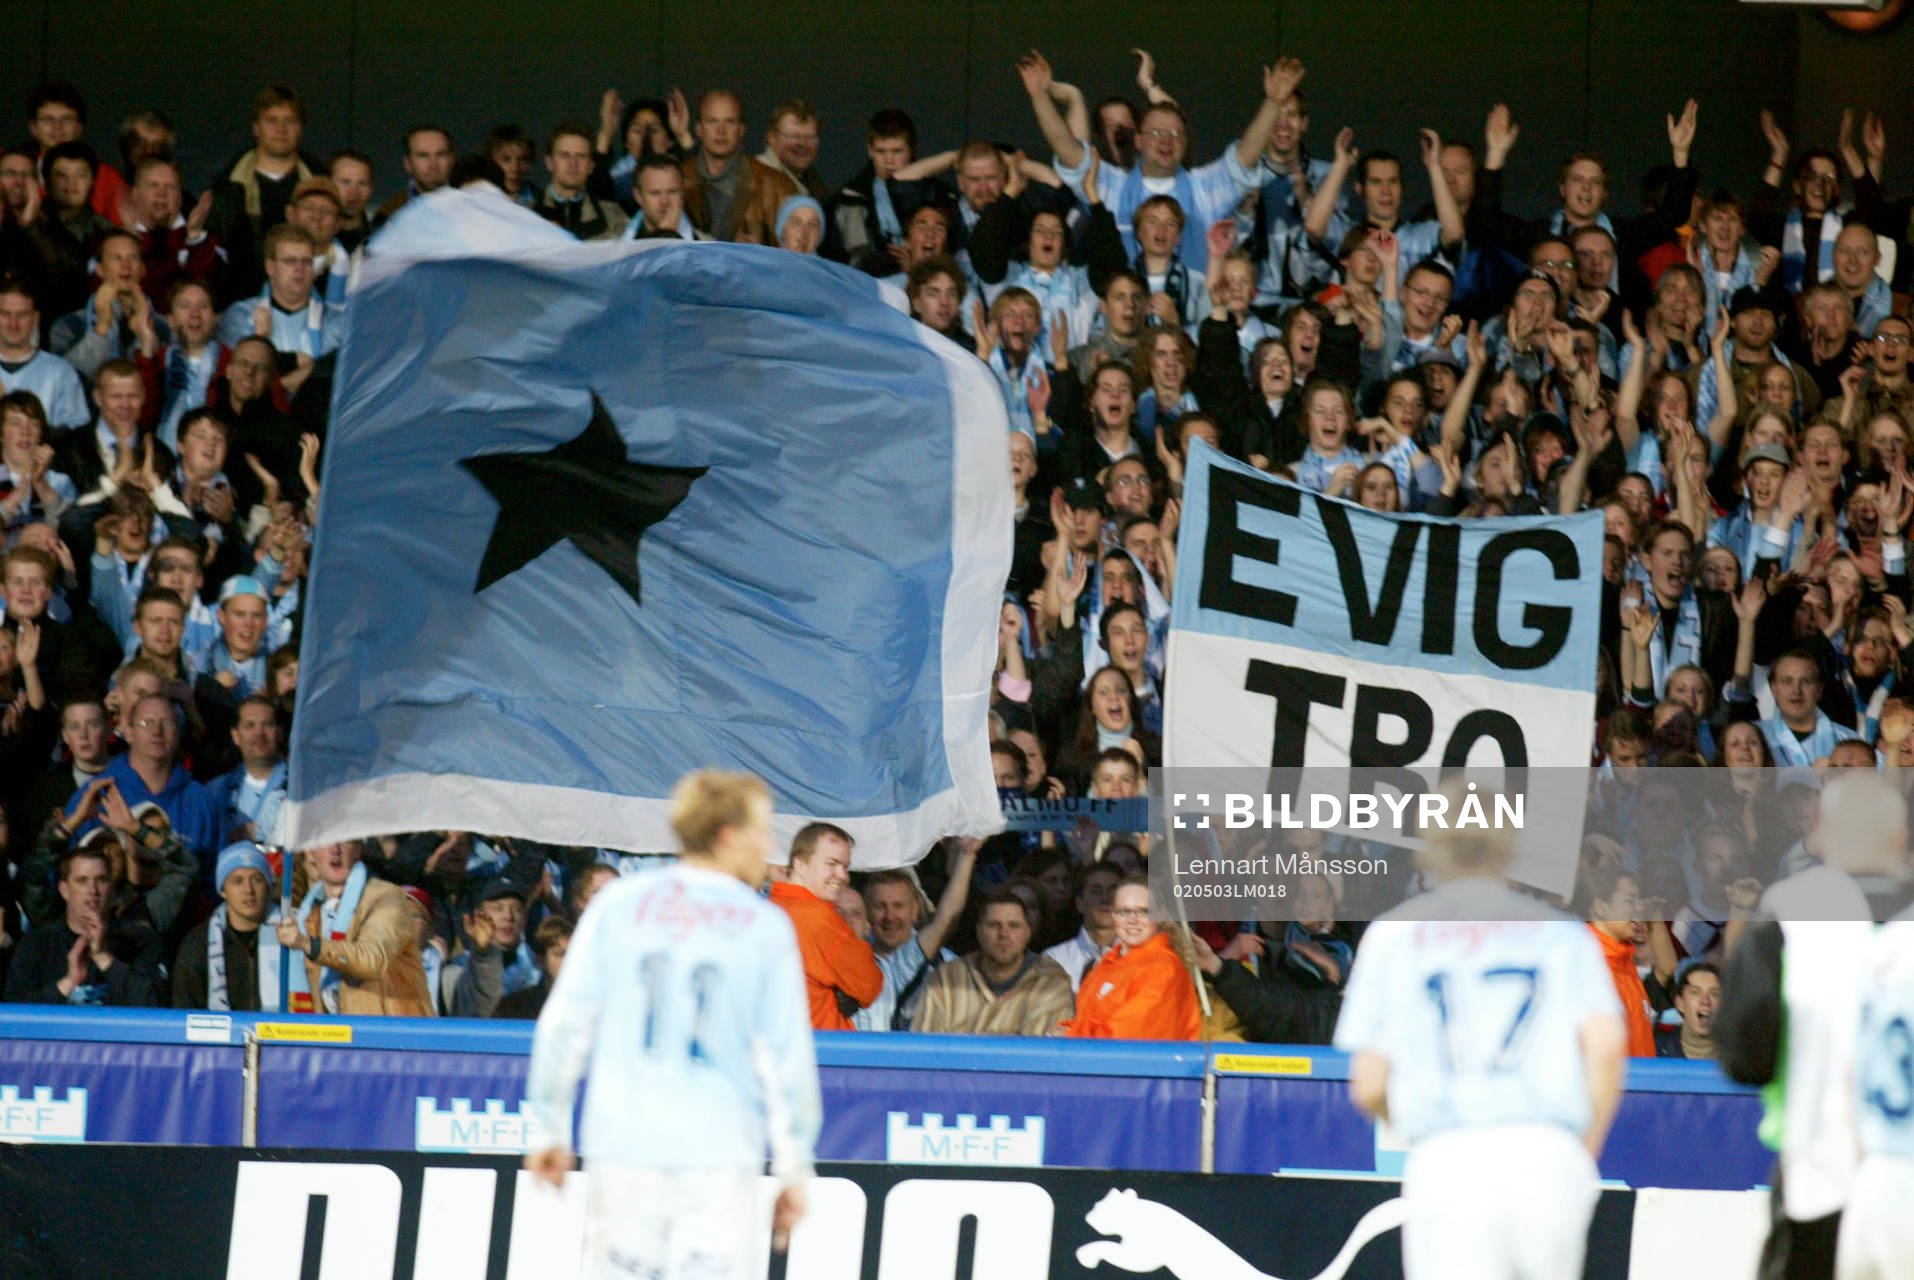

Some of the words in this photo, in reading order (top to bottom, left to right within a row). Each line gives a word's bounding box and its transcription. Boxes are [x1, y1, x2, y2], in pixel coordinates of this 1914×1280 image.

[1199, 463, 1580, 669] EVIG
[1244, 658, 1530, 838] TRO
[1424, 963, 1540, 1074] 17
